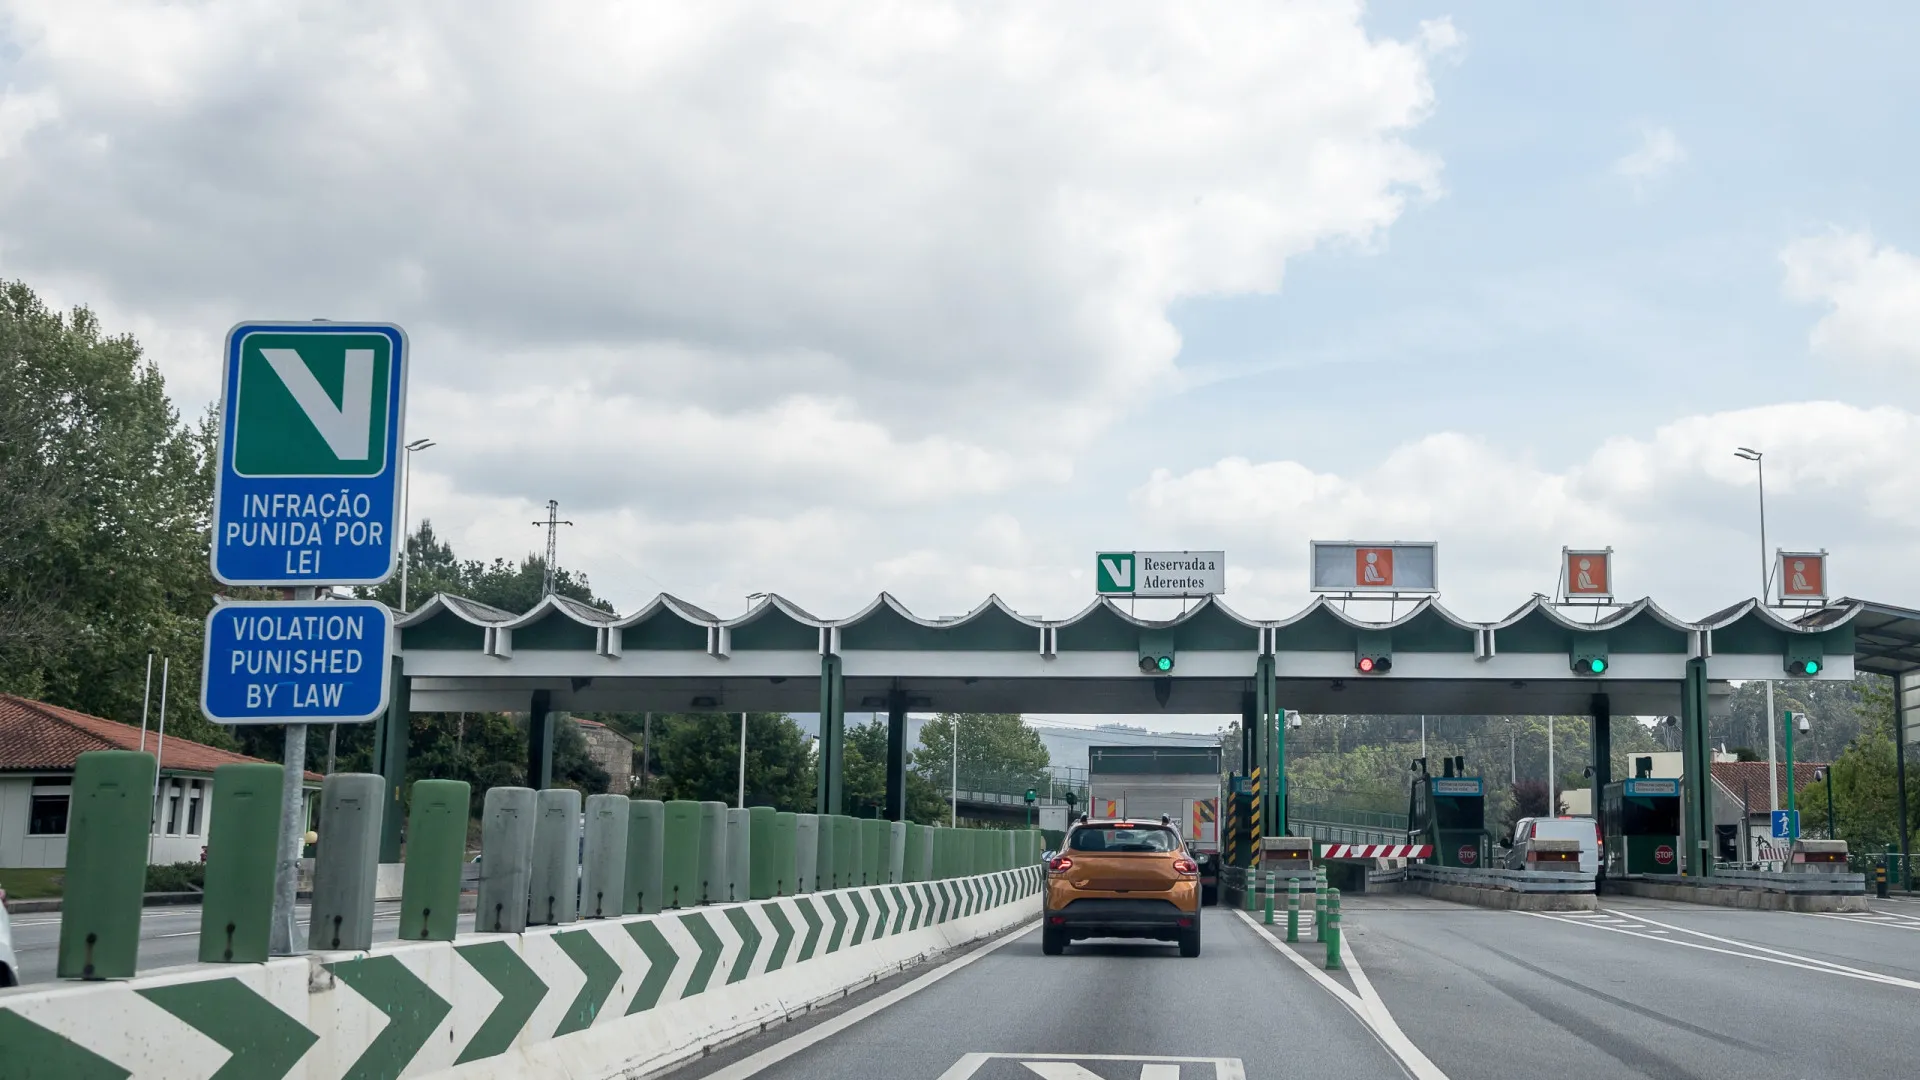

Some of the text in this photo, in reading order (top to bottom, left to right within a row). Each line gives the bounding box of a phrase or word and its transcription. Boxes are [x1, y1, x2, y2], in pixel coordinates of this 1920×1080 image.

[243, 489, 371, 525] INFRAÇÃO
[226, 521, 383, 546] PUNIDA POR
[286, 550, 320, 574] LEI
[1144, 558, 1215, 571] Reservada a
[1143, 576, 1205, 588] Aderentes
[233, 615, 363, 641] VIOLATION
[231, 649, 363, 675] PUNISHED
[246, 683, 343, 708] BY LAW
[1459, 851, 1477, 859] STOP
[1656, 851, 1673, 859] STOP
